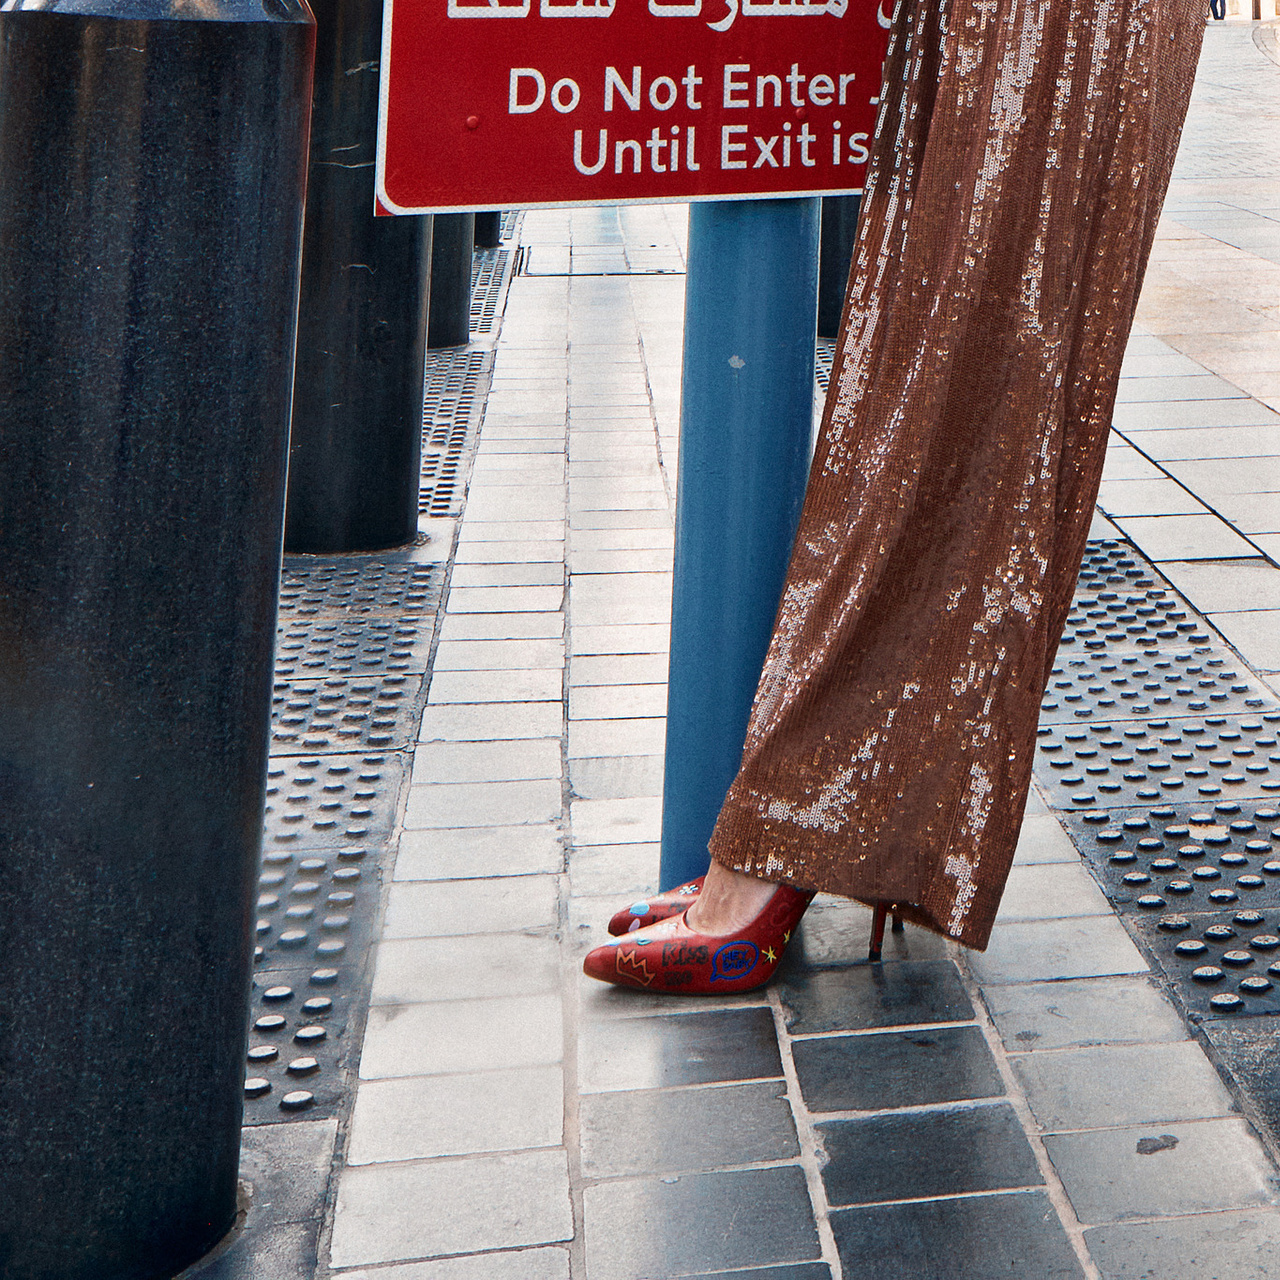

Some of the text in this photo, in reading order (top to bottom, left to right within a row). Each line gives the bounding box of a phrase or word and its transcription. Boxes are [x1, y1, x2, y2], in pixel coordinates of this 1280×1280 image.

[509, 68, 580, 113] Do
[605, 65, 702, 111] Not
[724, 63, 855, 111] Enter
[574, 121, 868, 175] Until Exit is
[722, 949, 749, 961] HEY
[723, 958, 752, 973] BABY
